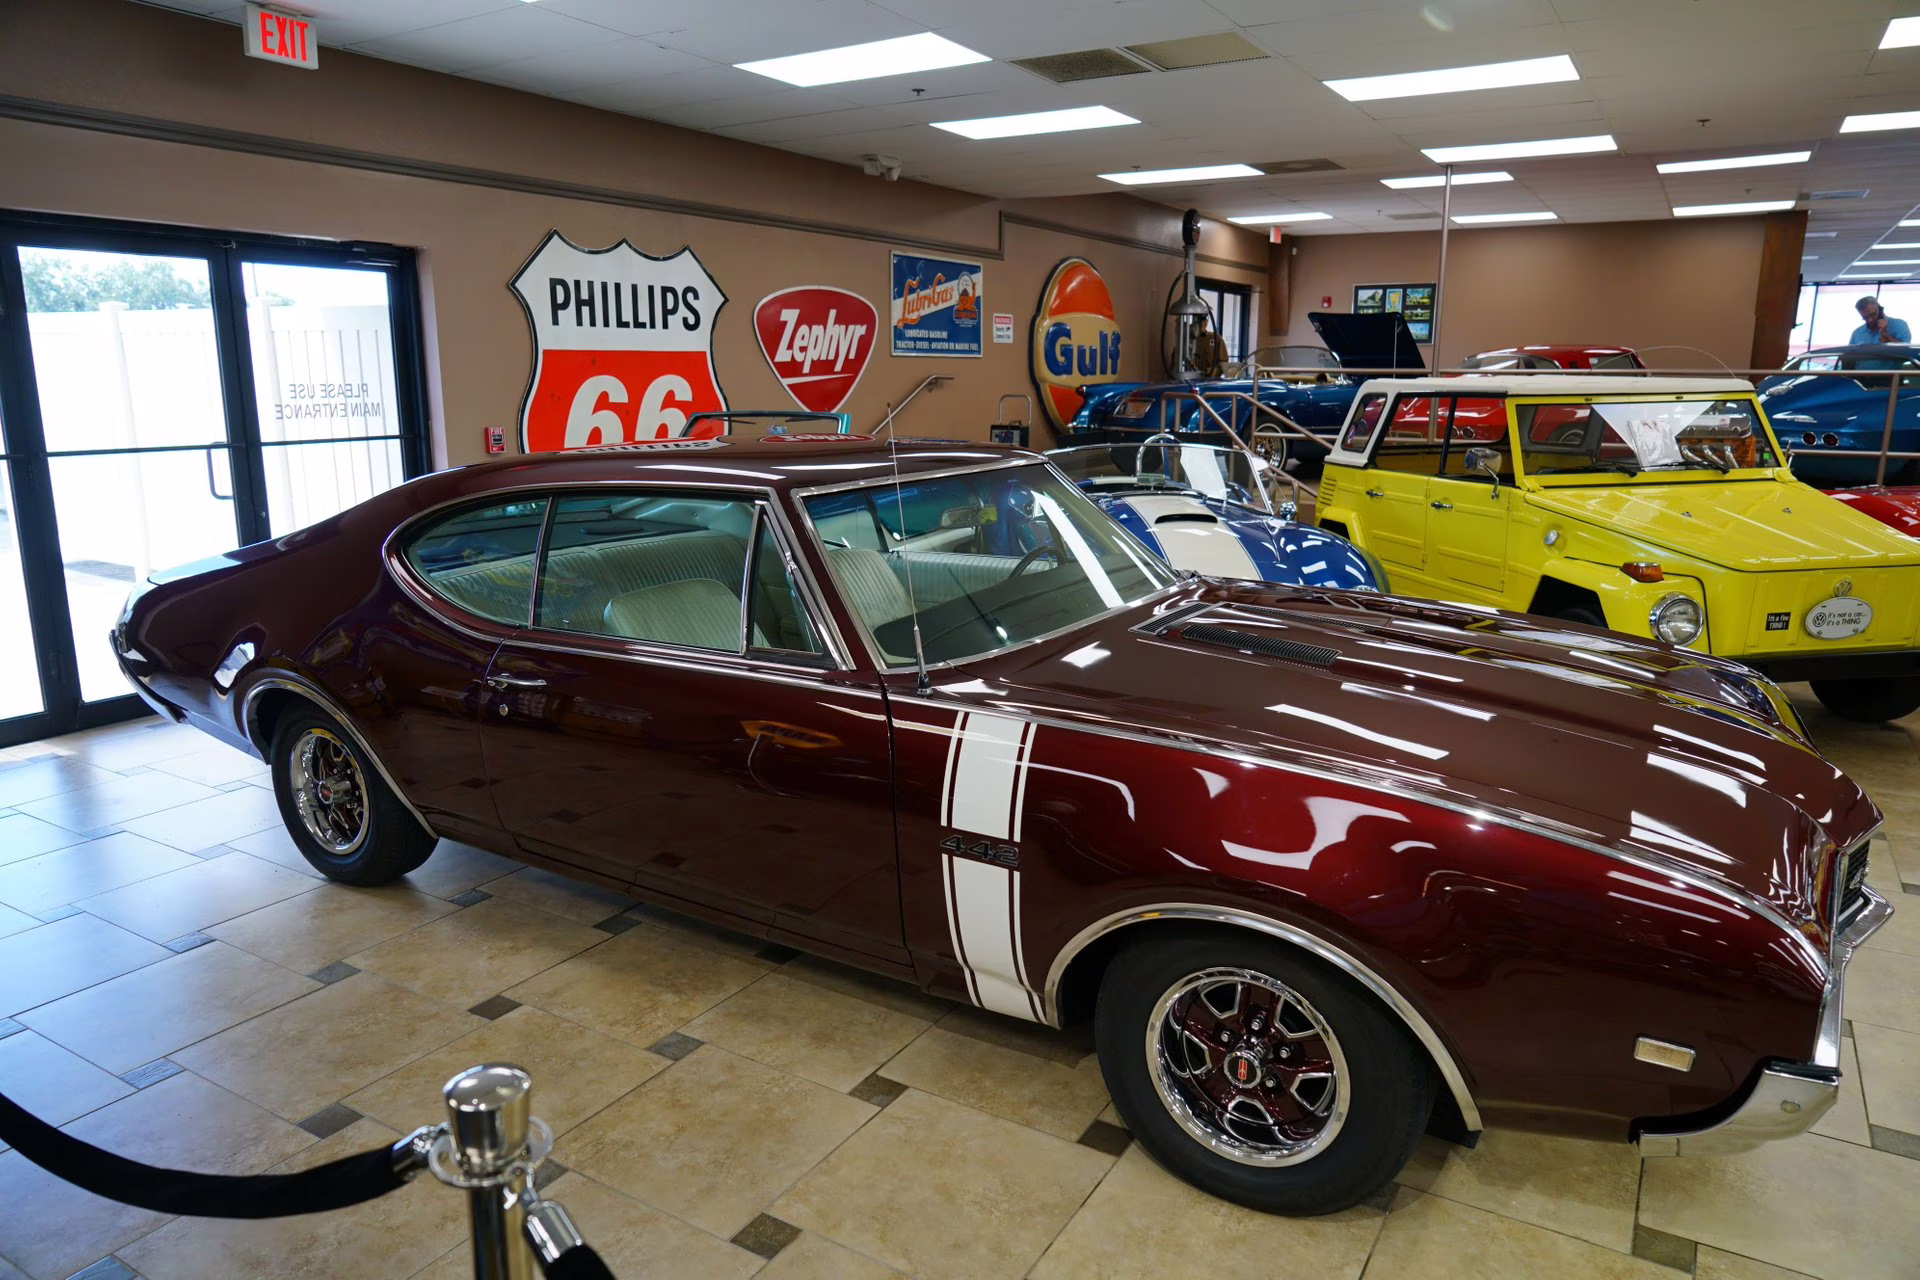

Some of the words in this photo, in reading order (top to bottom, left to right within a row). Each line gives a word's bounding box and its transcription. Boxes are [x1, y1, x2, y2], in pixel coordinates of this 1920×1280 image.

[260, 11, 308, 62] EXIT
[549, 277, 701, 331] PHILLIPS
[773, 308, 867, 374] Zephyr
[904, 329, 929, 338] LUBRICATED
[929, 331, 948, 339] GASOLINE
[1044, 322, 1121, 377] Gulf
[564, 374, 693, 448] 66
[940, 834, 1019, 867] 442
